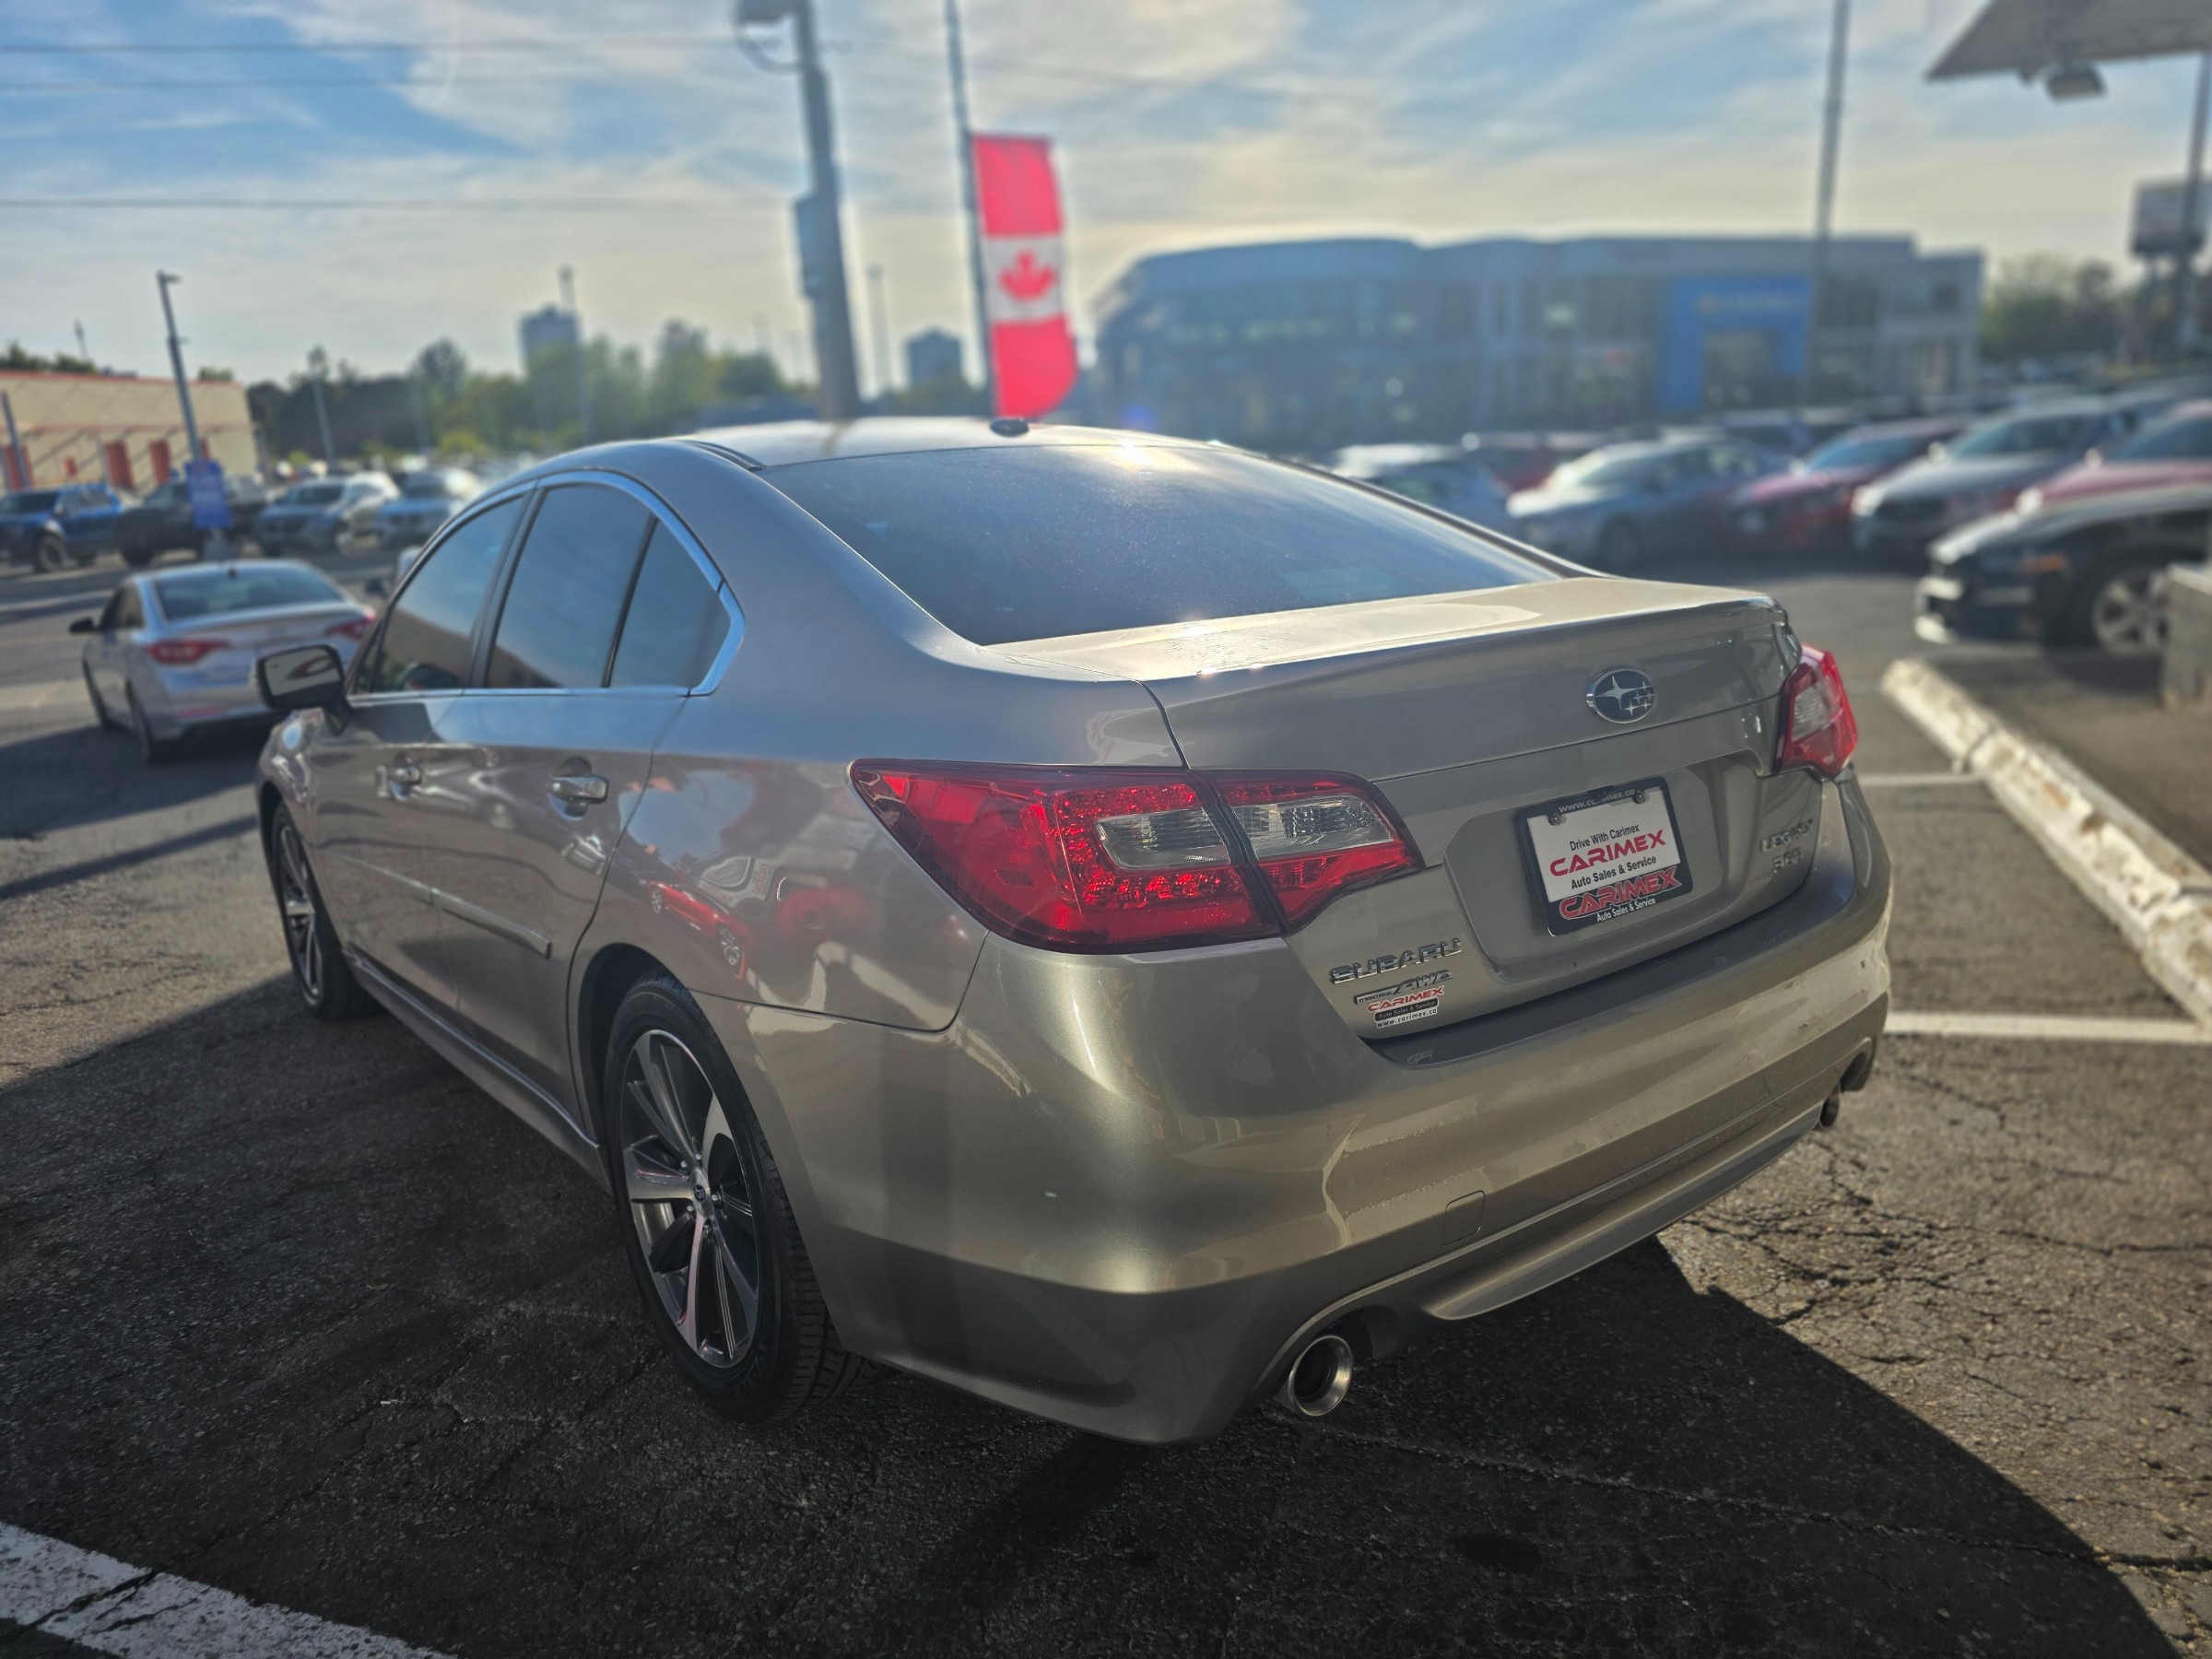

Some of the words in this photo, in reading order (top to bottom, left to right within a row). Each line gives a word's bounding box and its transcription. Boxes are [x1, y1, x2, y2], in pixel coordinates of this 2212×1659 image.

[1570, 839, 1591, 852] Drive
[1591, 831, 1608, 843] With
[1610, 824, 1640, 840] Carimex
[1549, 830, 1666, 877] CARIMEX
[1571, 877, 1591, 889] Auto
[1593, 869, 1617, 882] Sales
[1618, 864, 1626, 875] &
[1627, 855, 1657, 872] Service
[1559, 866, 1680, 919] CARIMEX
[1596, 912, 1612, 923] Auto
[1612, 905, 1629, 917] Sales
[1629, 903, 1634, 912] &
[1634, 897, 1656, 910] Service
[1330, 937, 1463, 983] SUBARU
[1394, 970, 1453, 994] AWD
[1368, 987, 1443, 1011] CARIMEX
[1416, 1001, 1435, 1010] Service
[1377, 1009, 1437, 1028] www.carimex.co
